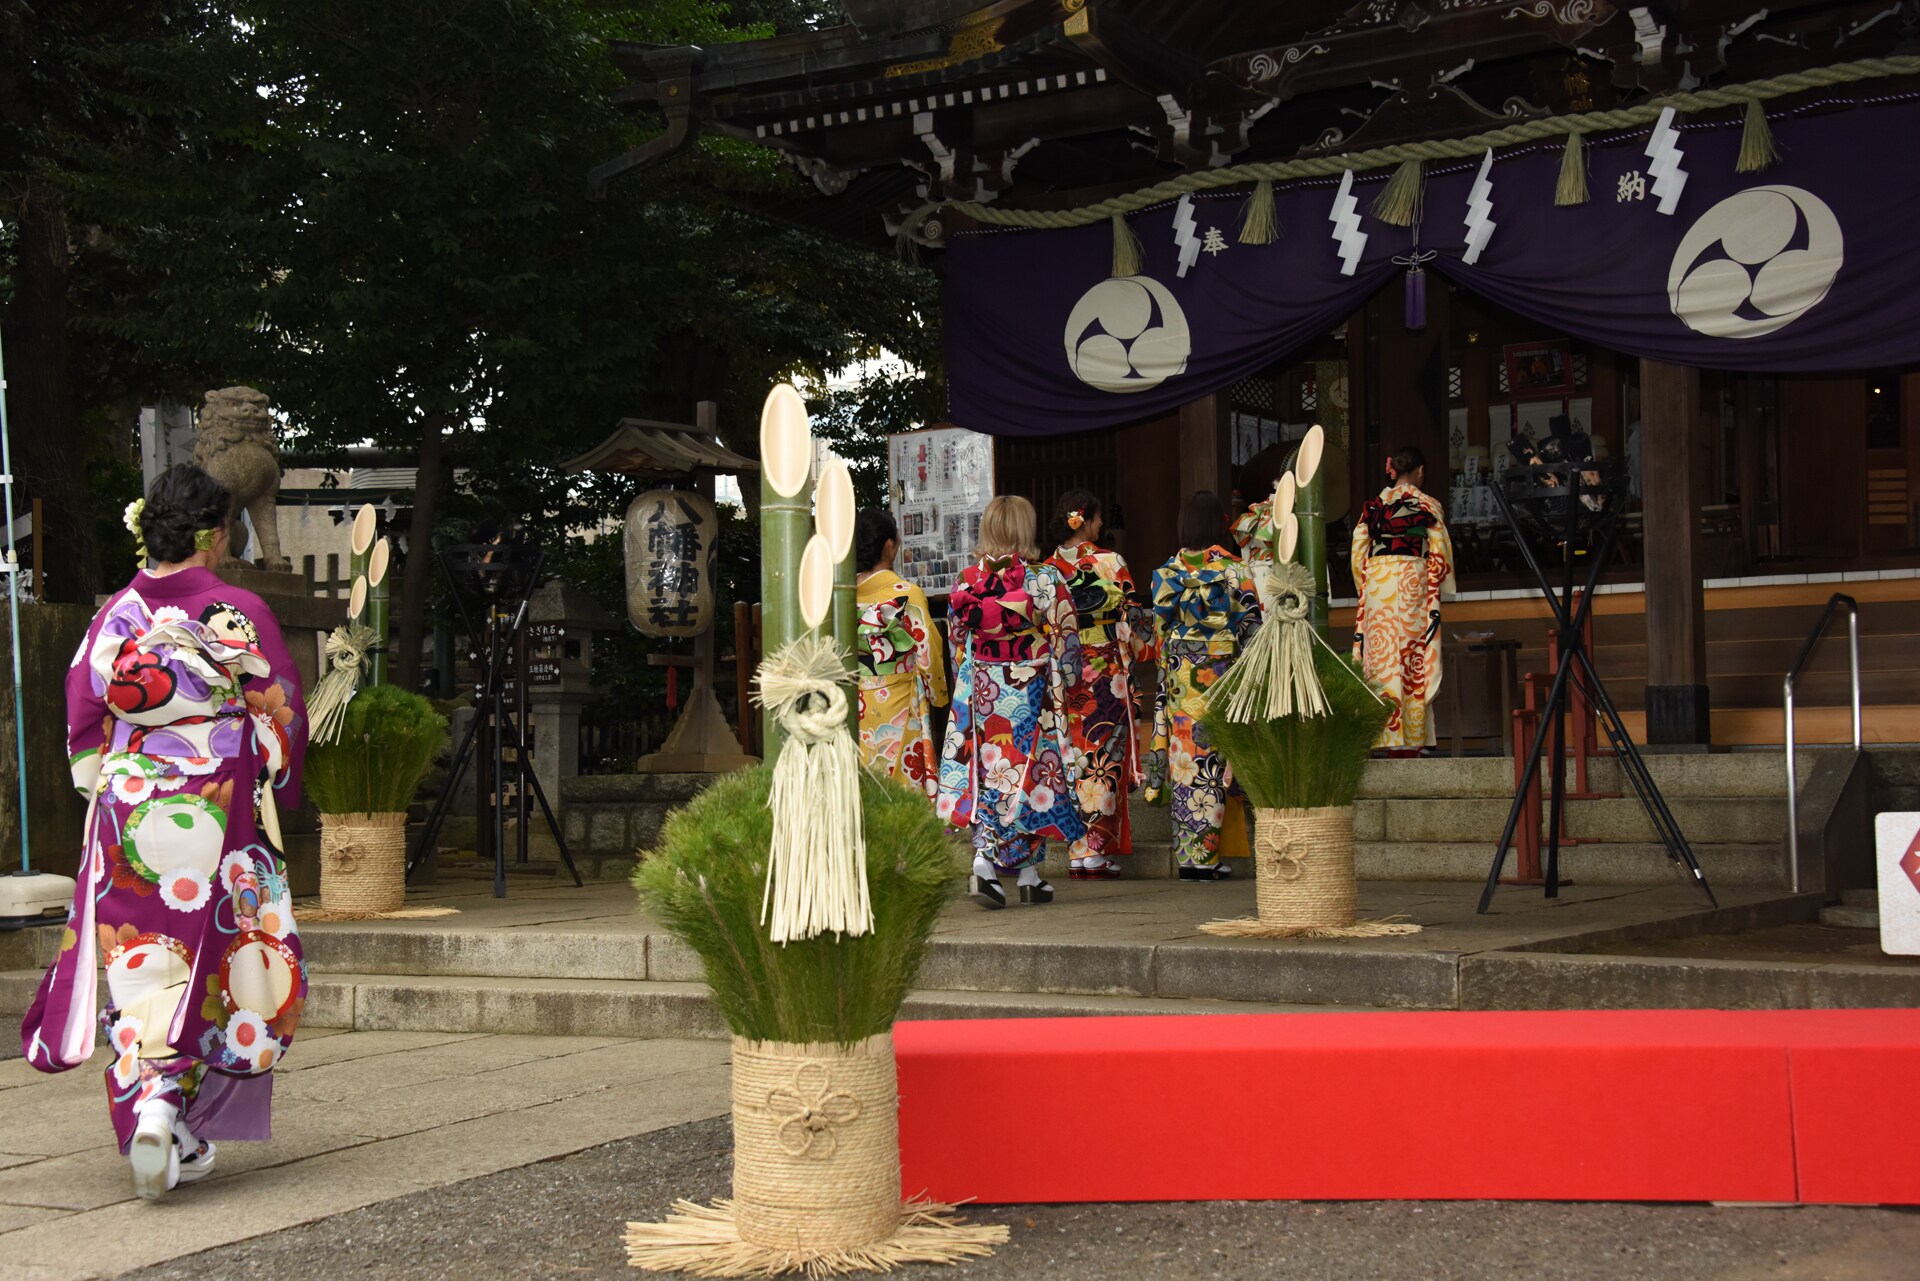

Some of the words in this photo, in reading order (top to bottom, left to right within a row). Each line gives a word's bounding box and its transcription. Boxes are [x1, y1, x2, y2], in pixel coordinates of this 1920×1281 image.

[1616, 170, 1646, 203] 納
[1199, 226, 1229, 257] 奉
[647, 497, 704, 626] 八幡神社
[528, 624, 556, 637] さざれ石
